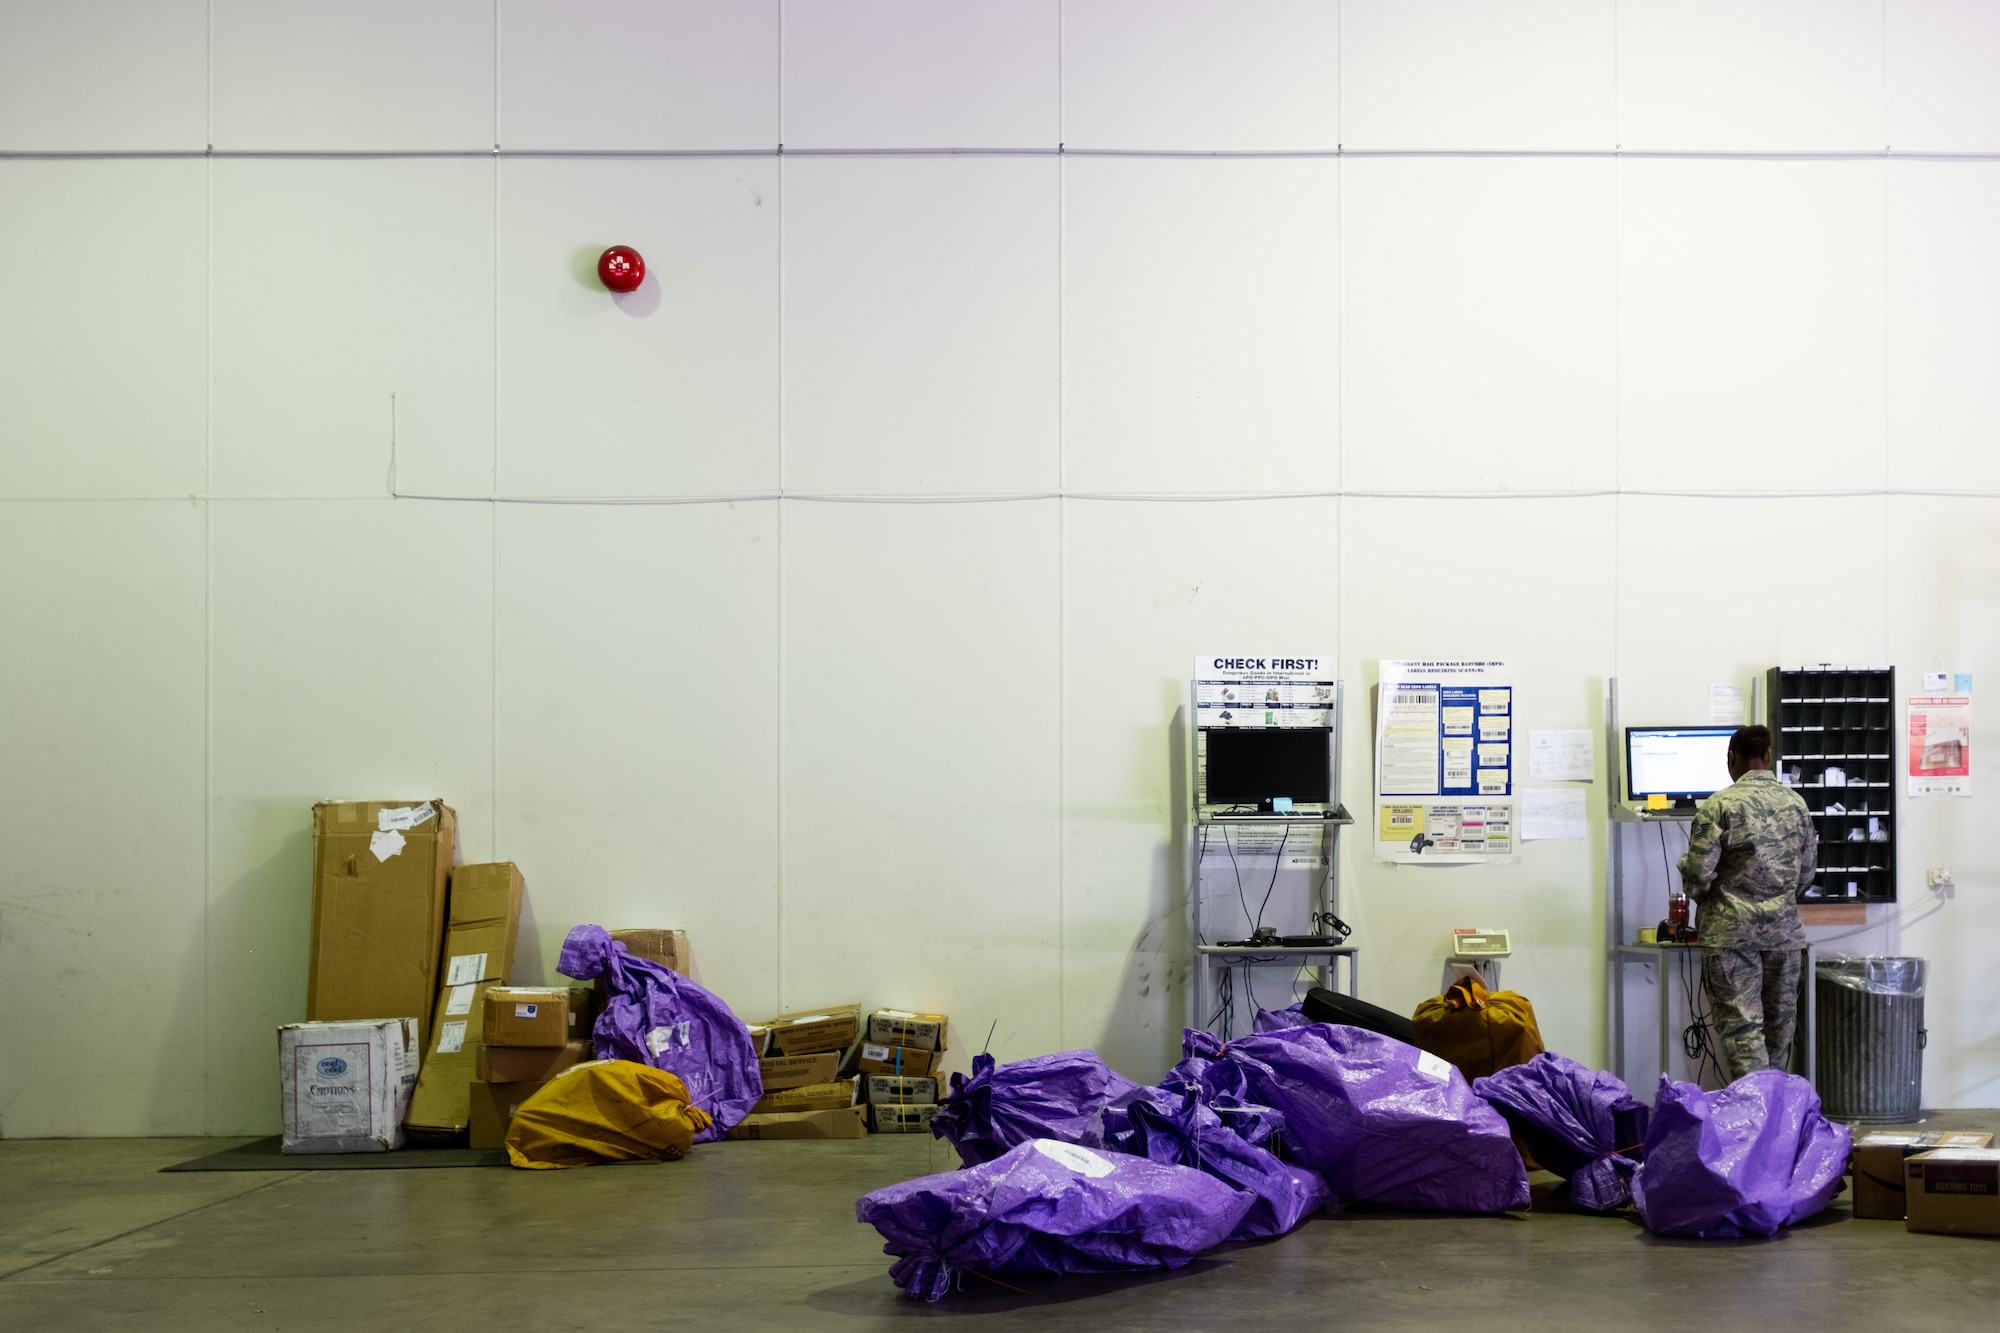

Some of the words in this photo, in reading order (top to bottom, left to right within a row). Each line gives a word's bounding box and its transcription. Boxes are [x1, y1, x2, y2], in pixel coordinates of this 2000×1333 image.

[1214, 659, 1267, 670] CHECK
[1272, 659, 1319, 670] FIRST!
[796, 1024, 814, 1033] STATES
[813, 1022, 833, 1031] POSTAL
[833, 1020, 853, 1028] SERVICE
[761, 1059, 787, 1068] POSTAL
[788, 1057, 817, 1066] SERVICE
[1936, 1182, 1967, 1191] BUILDING
[1969, 1182, 1988, 1192] TOYS
